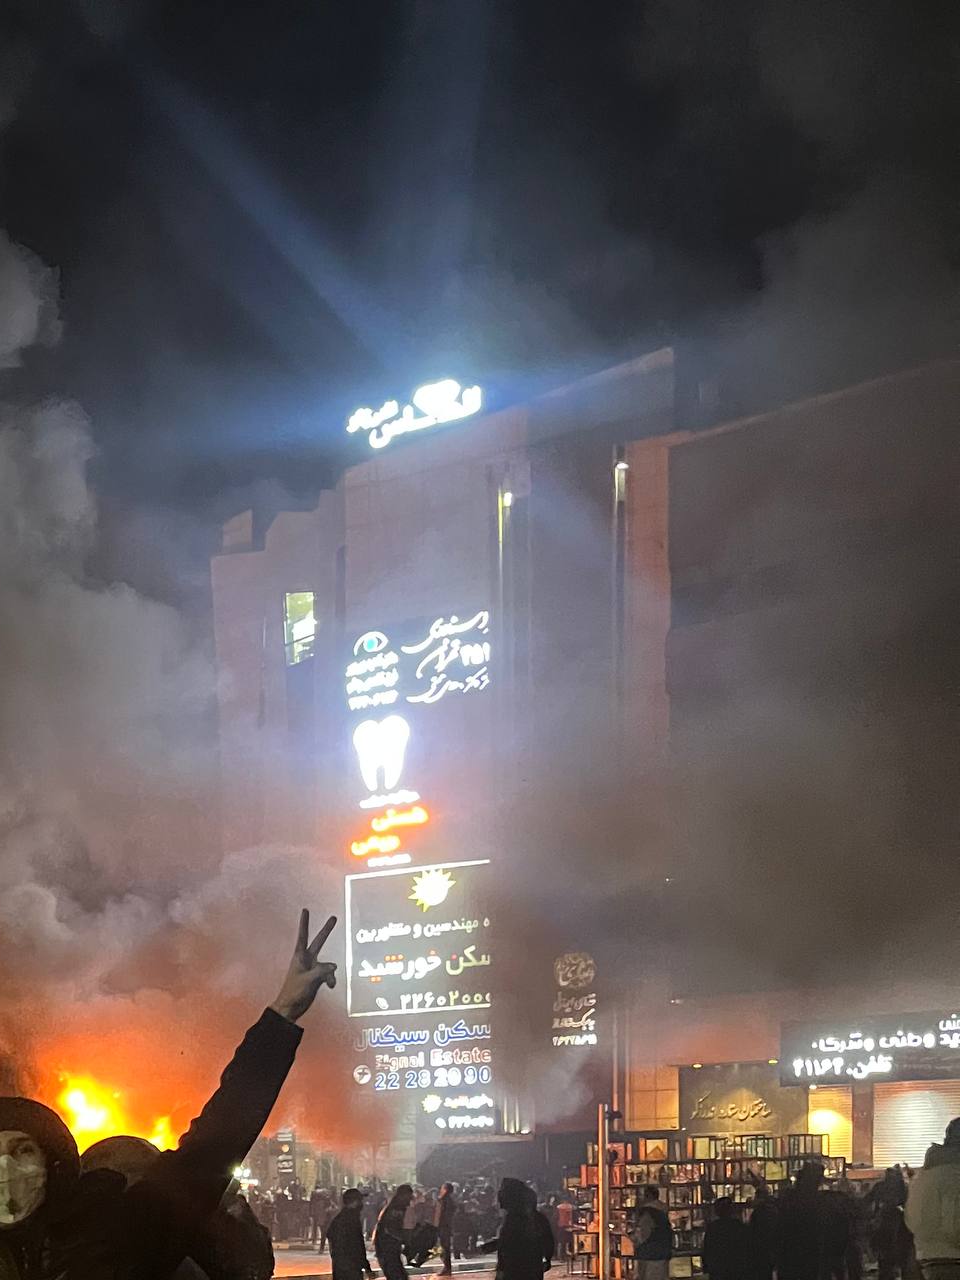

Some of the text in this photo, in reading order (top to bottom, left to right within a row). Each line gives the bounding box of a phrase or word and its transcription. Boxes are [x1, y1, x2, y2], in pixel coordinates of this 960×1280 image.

[413, 924, 422, 938] و
[423, 918, 478, 937] مهندسین
[358, 945, 490, 982] سکن خورشید
[353, 1019, 491, 1052] سکن سیگنال
[430, 1047, 491, 1067] Estate
